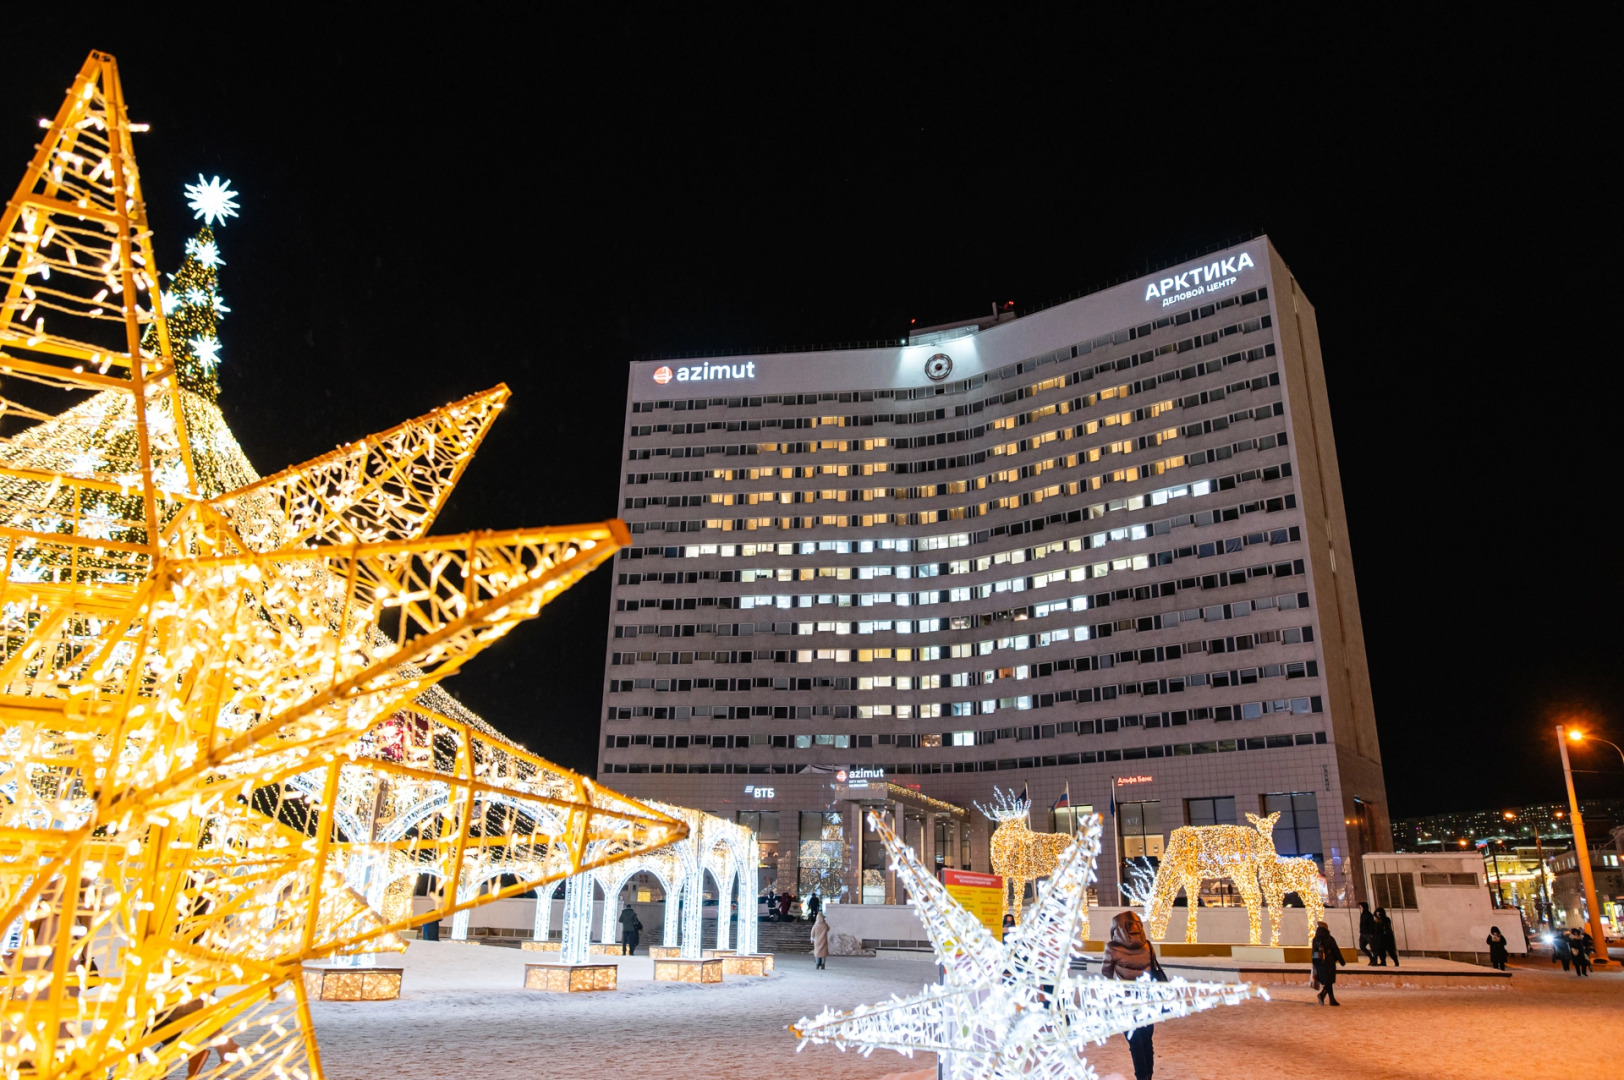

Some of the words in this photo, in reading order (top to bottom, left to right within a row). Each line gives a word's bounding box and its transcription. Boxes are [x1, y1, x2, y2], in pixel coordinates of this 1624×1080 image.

[1145, 252, 1255, 301] АРКТИКА
[1162, 286, 1205, 307] ДЕЛОВОЙ
[1206, 276, 1237, 293] ЦЕНТР
[676, 361, 755, 381] azimut
[849, 768, 884, 778] azimut
[753, 787, 775, 798] ВТБ
